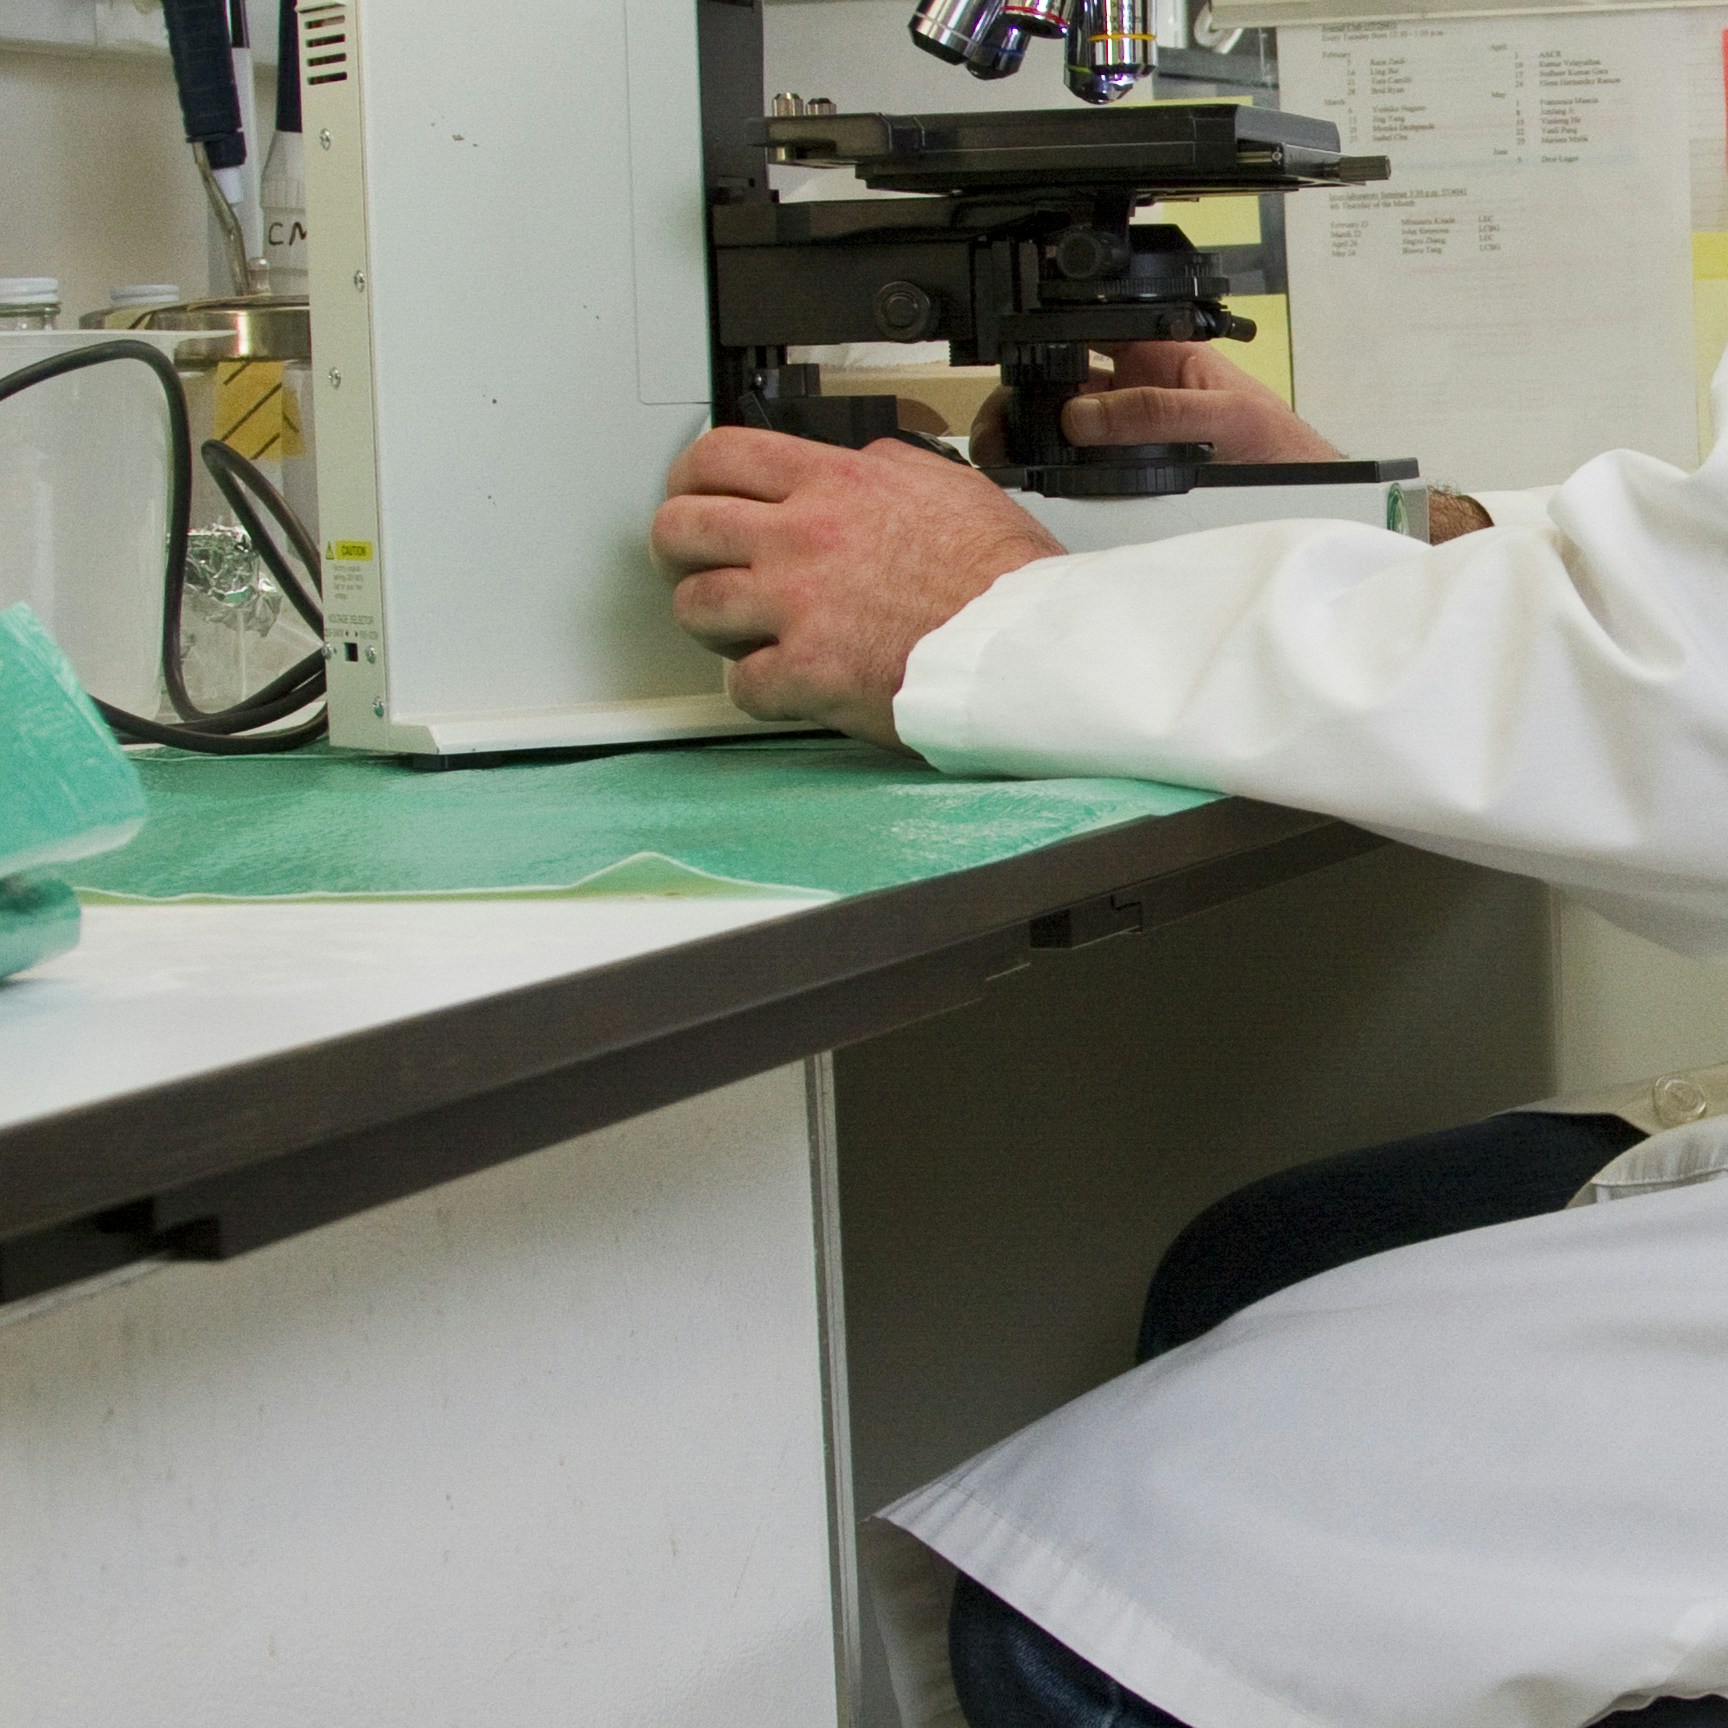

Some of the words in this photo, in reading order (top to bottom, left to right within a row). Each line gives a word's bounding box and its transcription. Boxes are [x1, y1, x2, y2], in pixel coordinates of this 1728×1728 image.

[1491, 91, 1506, 99] May
[1323, 98, 1346, 106] March
[1330, 230, 1353, 239] March
[1331, 240, 1349, 249] April
[1331, 250, 1346, 258] May
[341, 545, 367, 558] CAUTION
